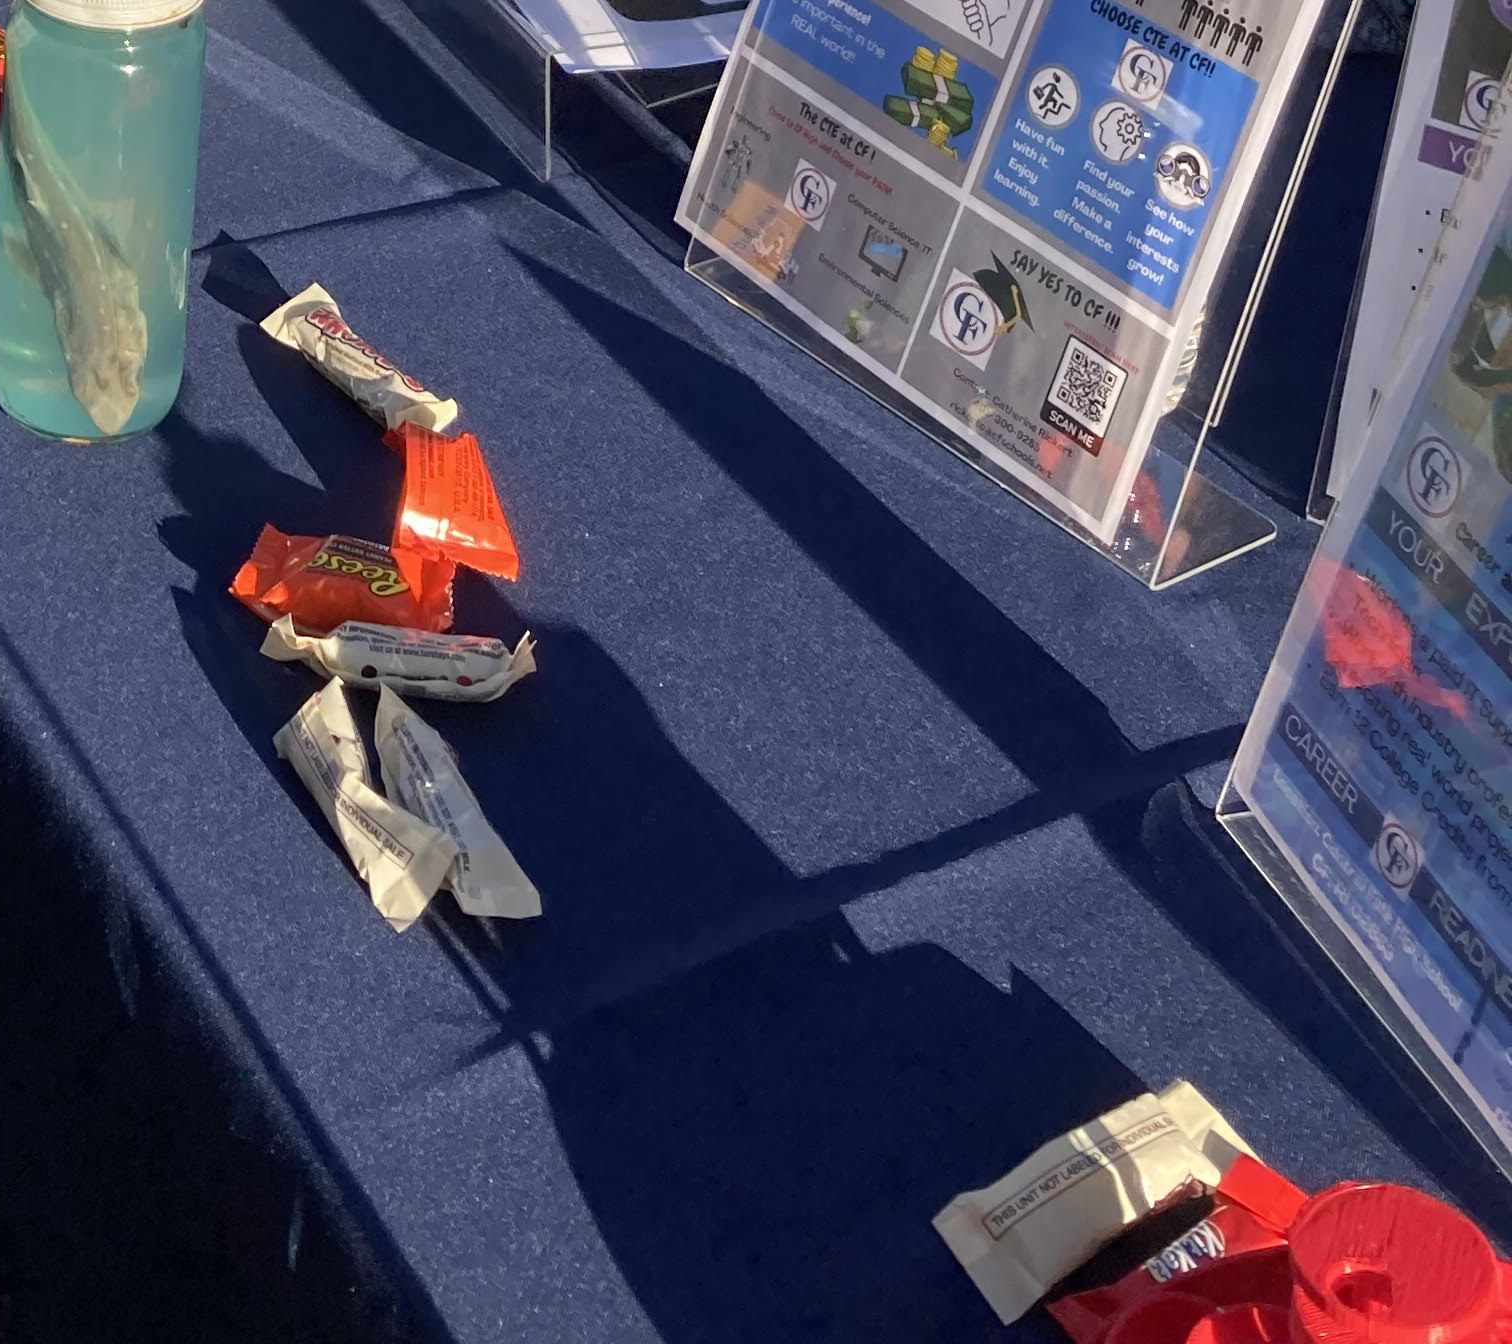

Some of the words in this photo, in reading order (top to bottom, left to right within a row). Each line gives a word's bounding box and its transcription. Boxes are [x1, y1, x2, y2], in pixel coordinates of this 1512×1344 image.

[791, 15, 820, 41] REAL
[864, 37, 887, 60] the
[1142, 25, 1168, 50] CTE
[1168, 40, 1190, 63] AT
[1188, 51, 1218, 79] CF!!
[800, 102, 818, 125] The
[819, 117, 841, 140] CTE
[839, 132, 855, 149] at
[854, 140, 870, 157] CF
[1014, 118, 1046, 146] Have
[1045, 138, 1066, 158] fun
[1007, 157, 1040, 185] Enjoy
[1011, 139, 1039, 162] with
[1037, 153, 1050, 170] it.
[993, 169, 1041, 207] learning.
[1075, 179, 1122, 214] passion.
[1082, 160, 1107, 182] Find
[1104, 175, 1136, 199] your
[847, 193, 889, 228] Computer
[888, 220, 922, 249] Science
[1053, 208, 1115, 255] difference.
[1071, 197, 1103, 224] Make
[1102, 219, 1114, 231] a
[1143, 223, 1175, 246] your
[1144, 198, 1168, 221] See
[1167, 211, 1196, 237] how
[1125, 231, 1181, 274] interests
[1126, 257, 1166, 286] grow!
[1009, 249, 1039, 276] SAY
[1037, 267, 1062, 295] YES
[1065, 284, 1083, 308] TO
[1083, 300, 1105, 320] CF
[991, 395, 1039, 433] Catherine
[1048, 409, 1080, 439] SCAN
[1076, 429, 1097, 449] ME
[1387, 511, 1446, 585] YOUR
[1455, 520, 1501, 574] Career
[1404, 694, 1468, 776] industry
[1284, 712, 1360, 814] CAREER
[1369, 729, 1420, 796] College
[1420, 790, 1474, 861] Credits
[1431, 764, 1473, 817] world
[339, 796, 383, 841] INDIVIDUAL
[991, 1206, 1017, 1229] THIS
[1014, 1188, 1042, 1210] UNIT
[1039, 1172, 1062, 1196] NOT
[1062, 1151, 1103, 1182] LABELED
[1100, 1136, 1122, 1160] FOR
[1119, 1118, 1167, 1148] INDIVIDUAL
